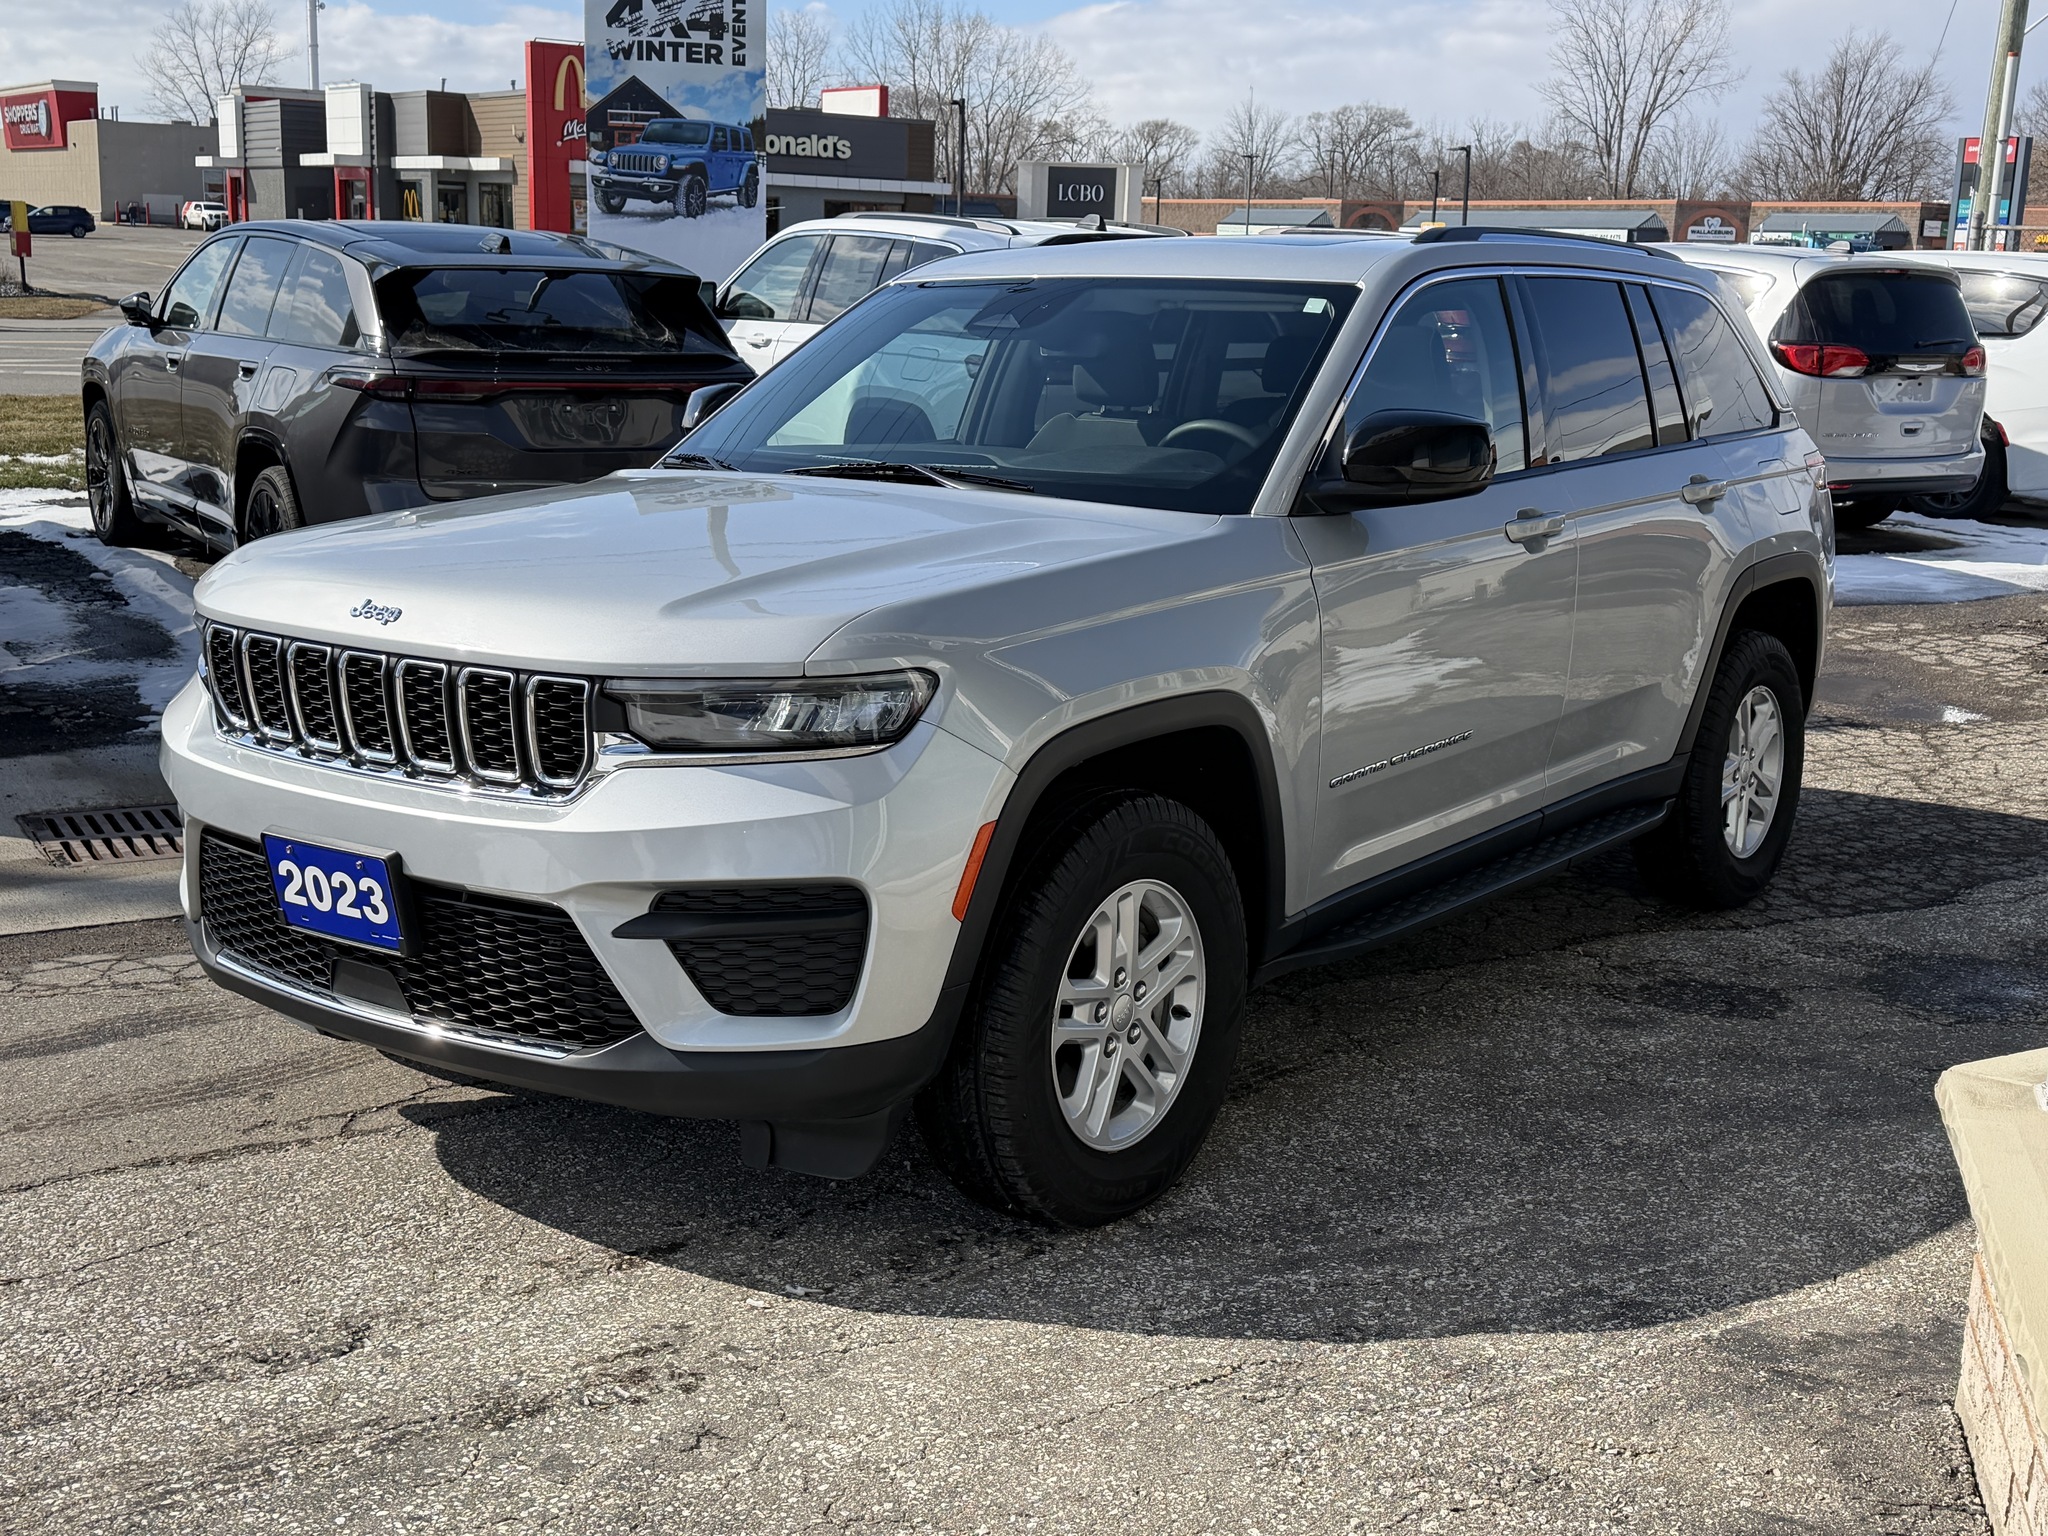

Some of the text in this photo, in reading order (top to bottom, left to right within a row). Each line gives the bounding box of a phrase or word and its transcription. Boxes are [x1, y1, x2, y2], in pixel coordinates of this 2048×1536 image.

[606, 39, 724, 65] WINTER
[4, 103, 38, 124] SHOPPERS
[1058, 183, 1104, 202] LCBO
[350, 598, 402, 626] Jeep
[1329, 729, 1474, 788] GRAND CHEROKEE
[278, 859, 389, 925] 2023
